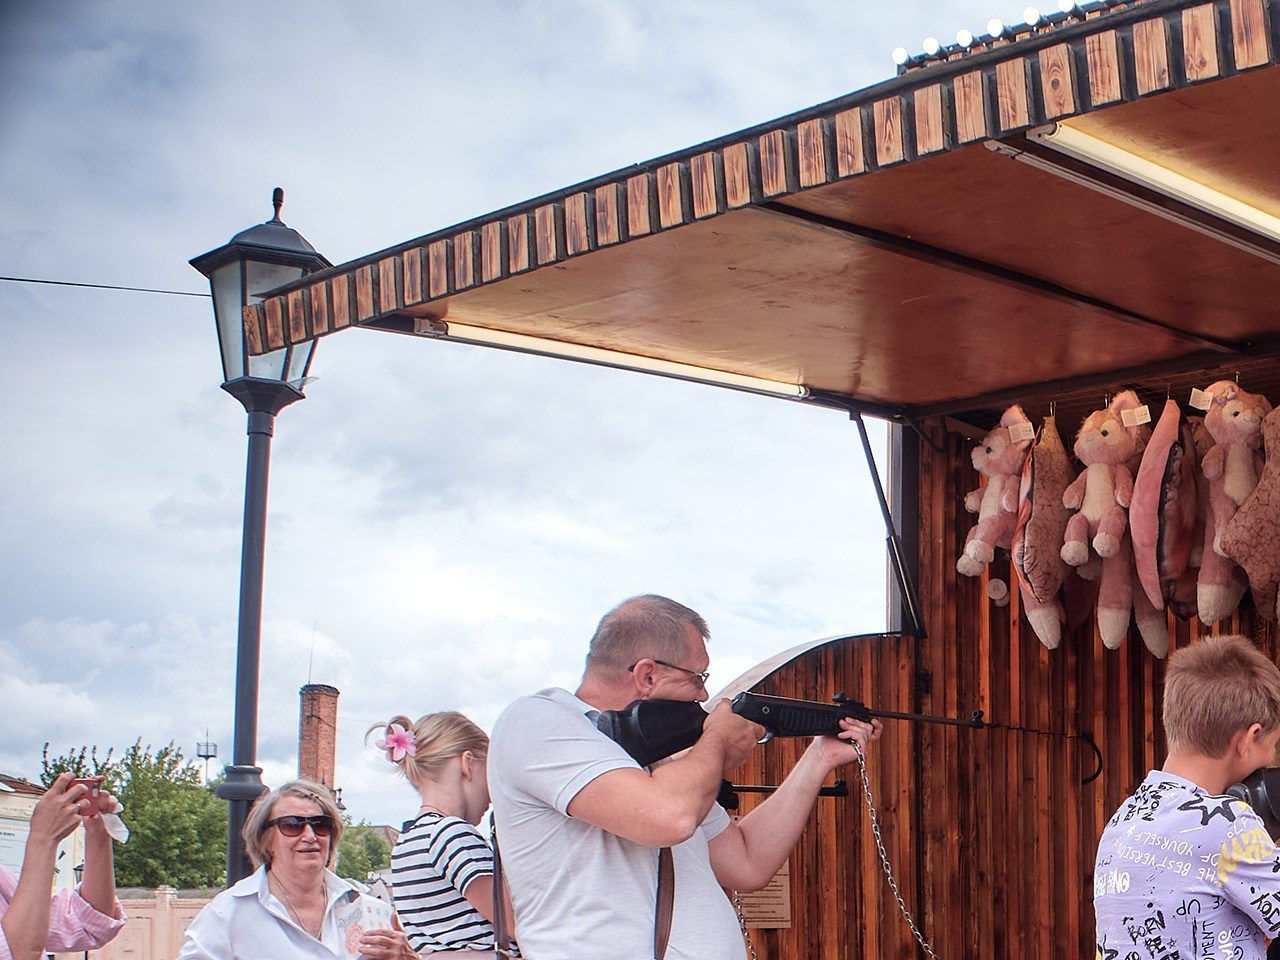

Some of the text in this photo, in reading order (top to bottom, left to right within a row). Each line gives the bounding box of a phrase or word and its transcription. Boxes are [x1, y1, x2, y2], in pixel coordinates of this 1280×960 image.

[1134, 832, 1220, 867] OF YOURSELF
[1156, 856, 1192, 876] BEST
[1196, 868, 1219, 884] HE
[1127, 910, 1166, 946] BORN
[1144, 936, 1167, 959] BE
